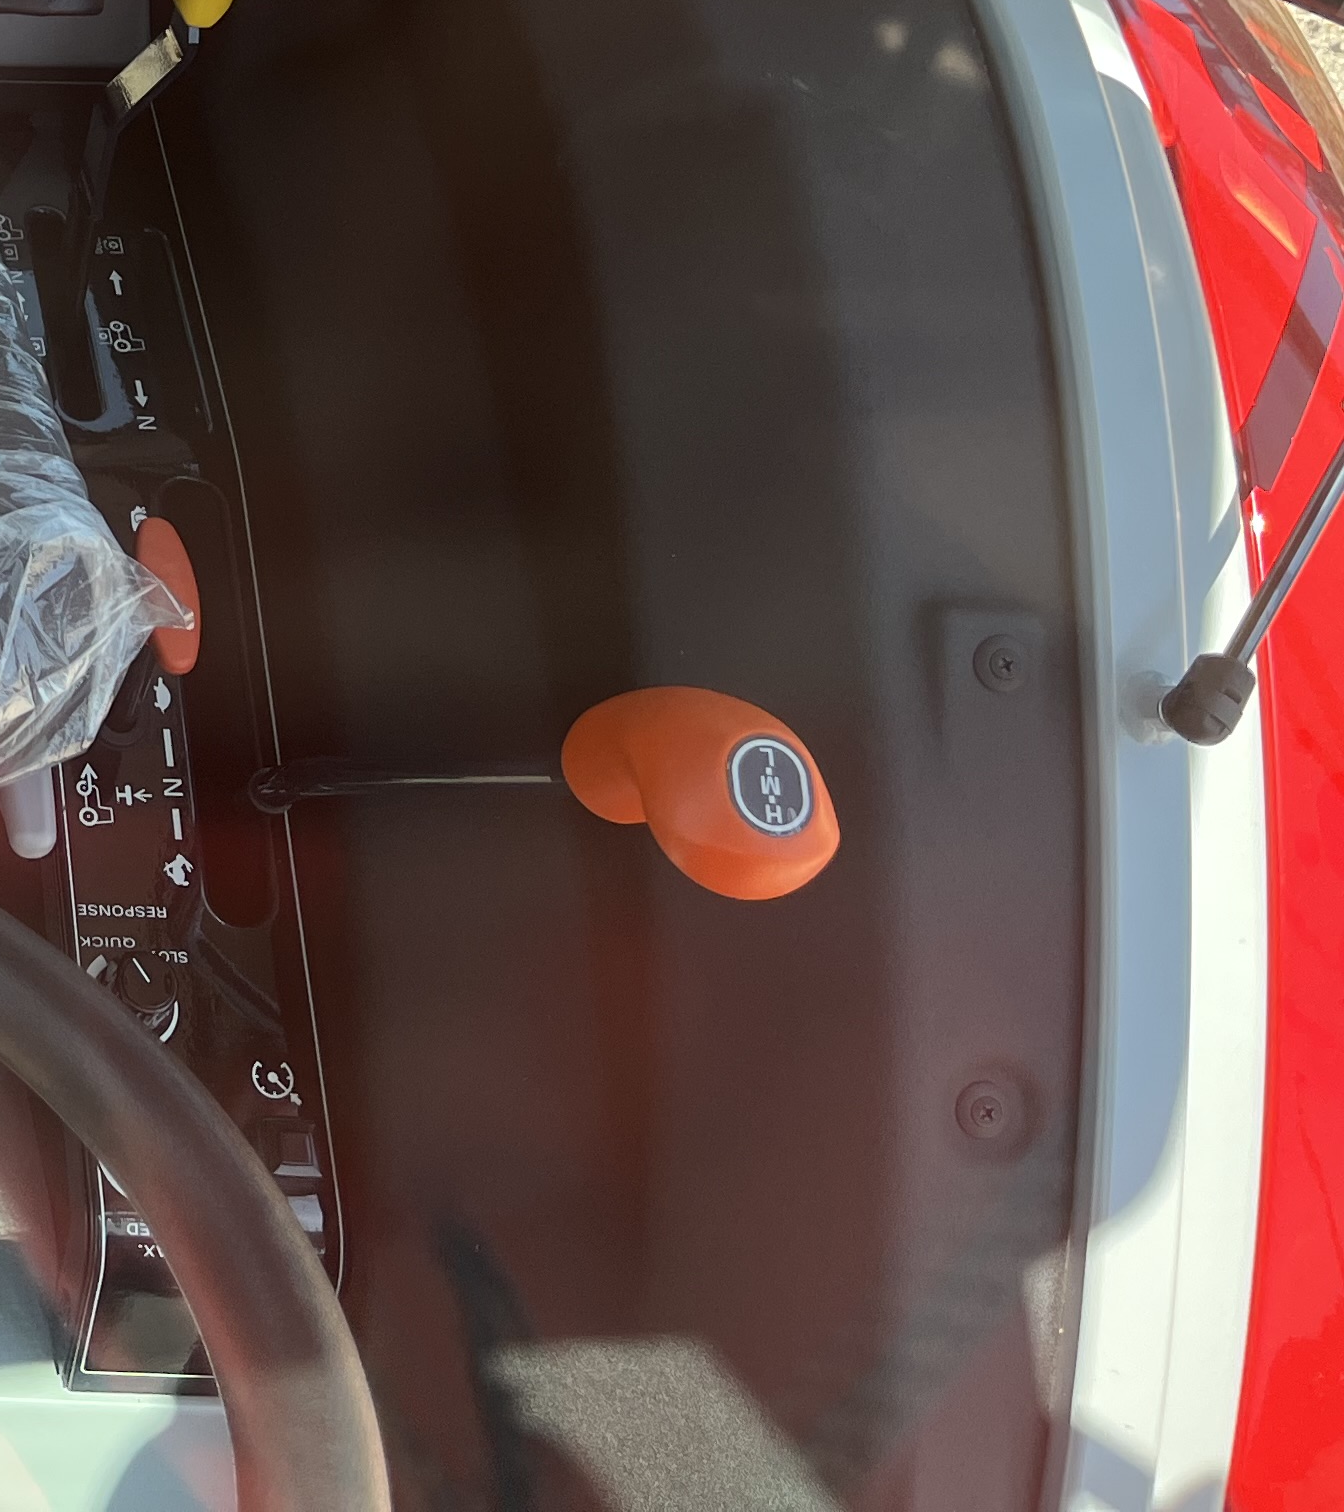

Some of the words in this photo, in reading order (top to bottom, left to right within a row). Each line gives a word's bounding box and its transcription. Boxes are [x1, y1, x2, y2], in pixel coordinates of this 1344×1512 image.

[136, 415, 158, 431] N
[162, 778, 184, 797] N
[77, 904, 168, 919] RESPONSE
[79, 935, 136, 948] QUICK
[151, 950, 189, 964] SLO
[126, 1222, 151, 1236] ED
